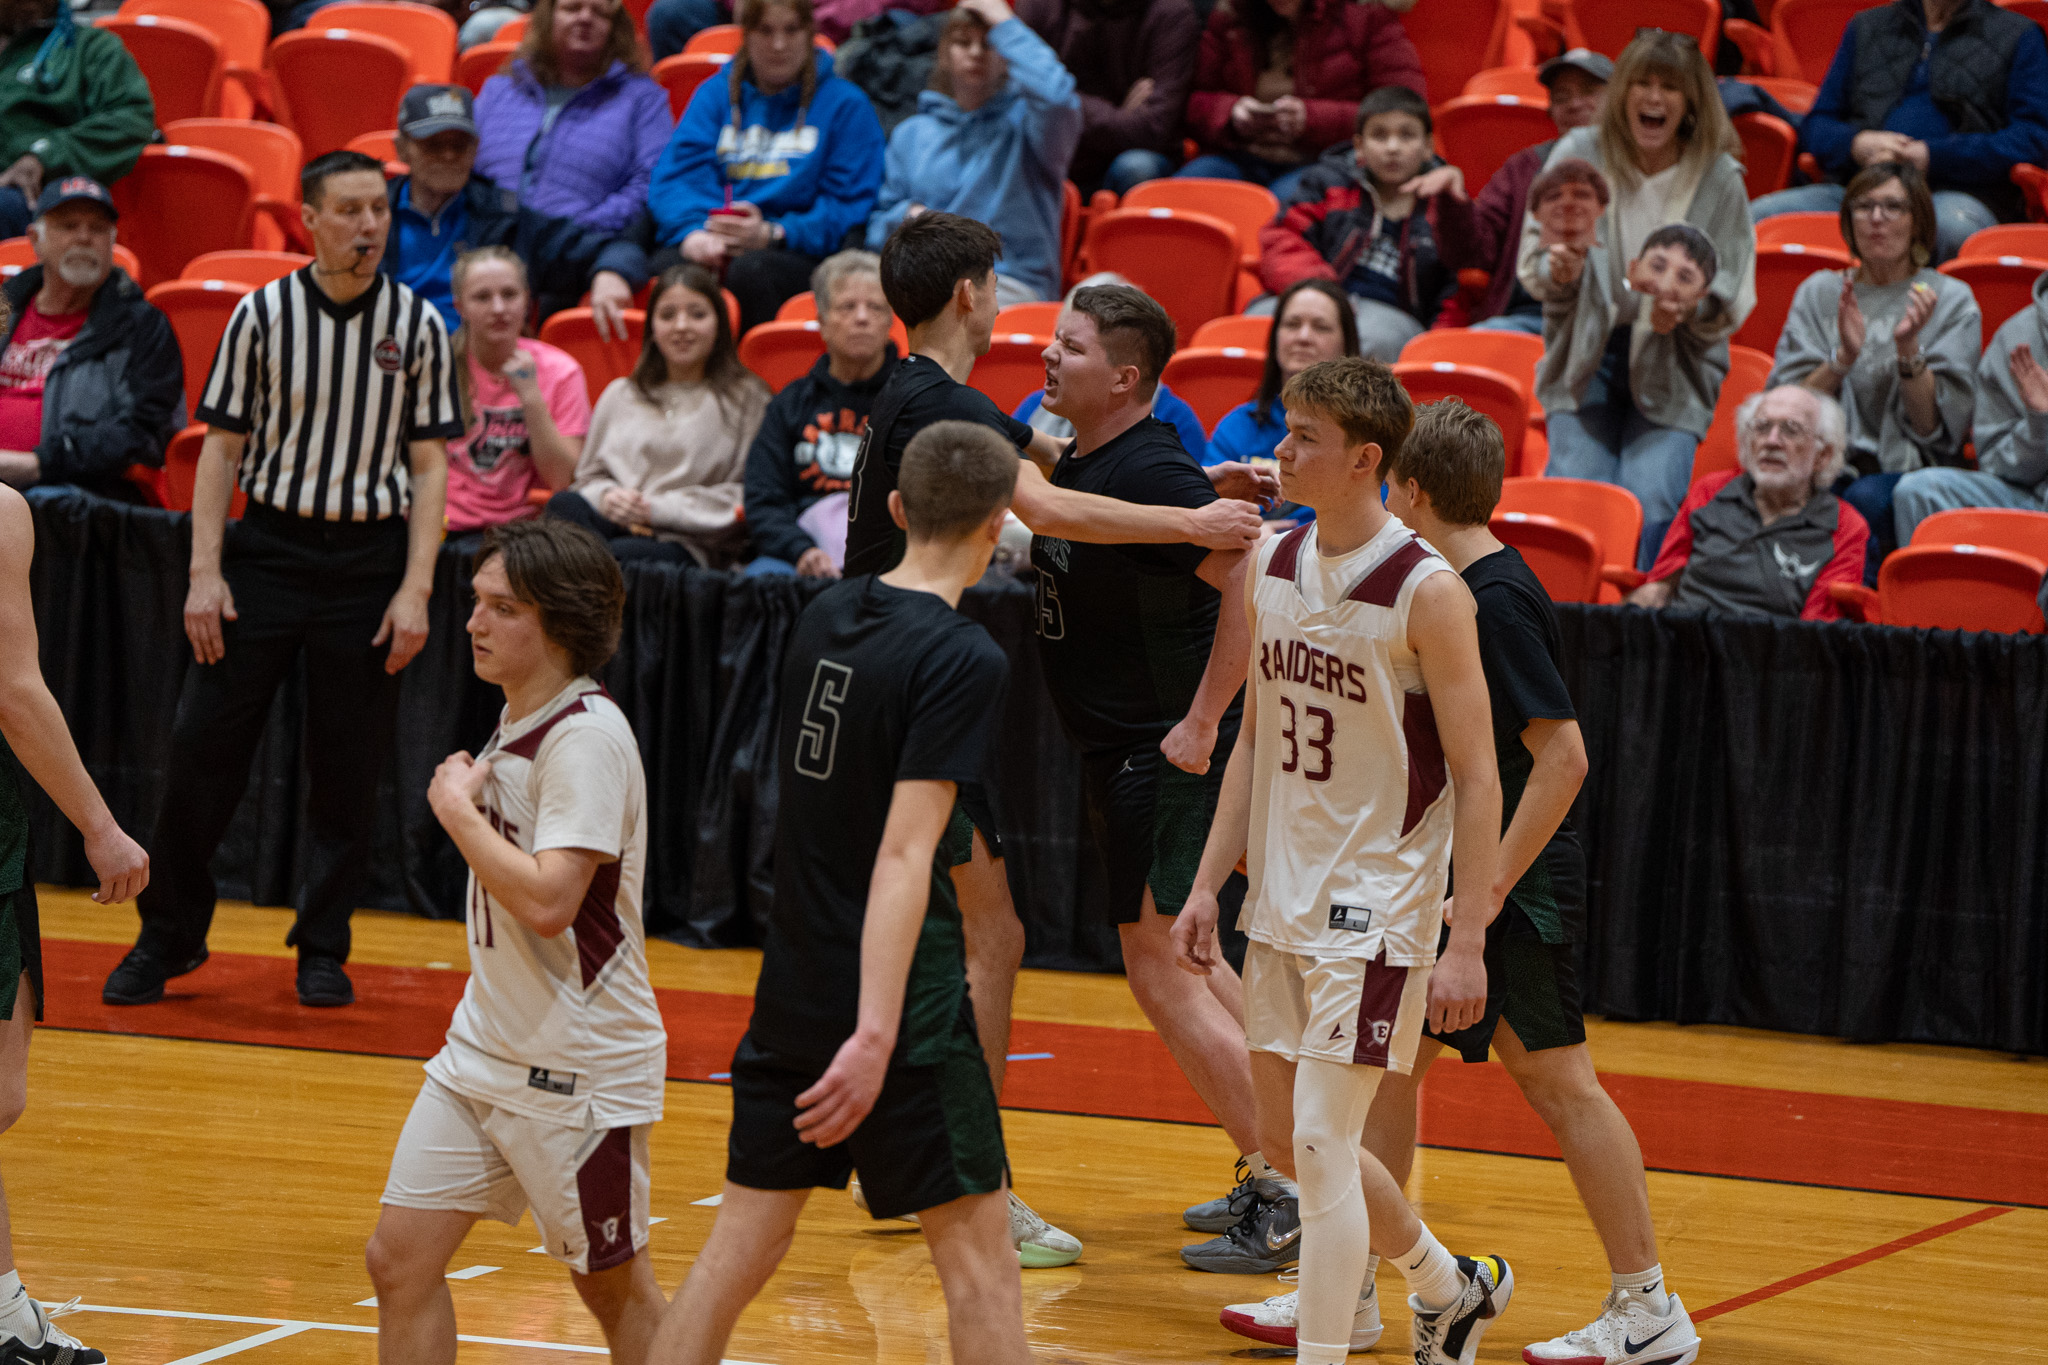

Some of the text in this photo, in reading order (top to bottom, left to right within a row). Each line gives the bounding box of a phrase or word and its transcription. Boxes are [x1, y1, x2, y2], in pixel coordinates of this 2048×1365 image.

[1259, 639, 1367, 704] RAIDERS
[794, 658, 853, 781] 5
[1279, 694, 1336, 783] 33
[1352, 920, 1358, 928] L
[1377, 1026, 1388, 1039] E
